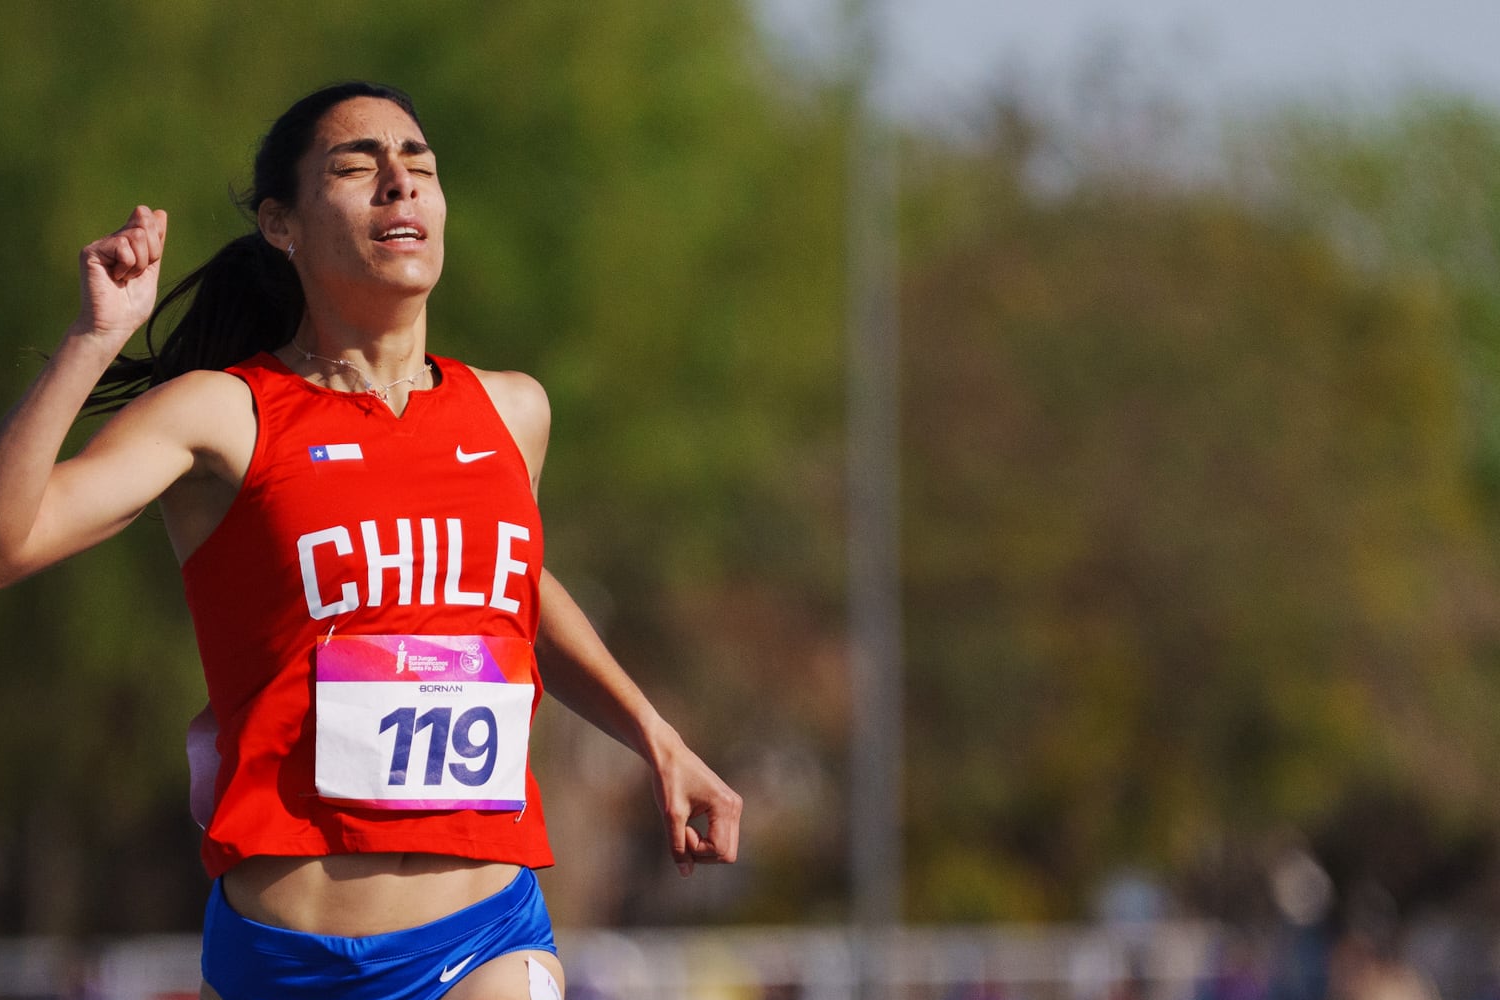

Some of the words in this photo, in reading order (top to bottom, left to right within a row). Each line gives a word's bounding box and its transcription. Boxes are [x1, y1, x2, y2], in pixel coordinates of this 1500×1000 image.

[297, 518, 530, 620] CHILE
[419, 684, 463, 693] BORNAN
[379, 706, 498, 787] 119
